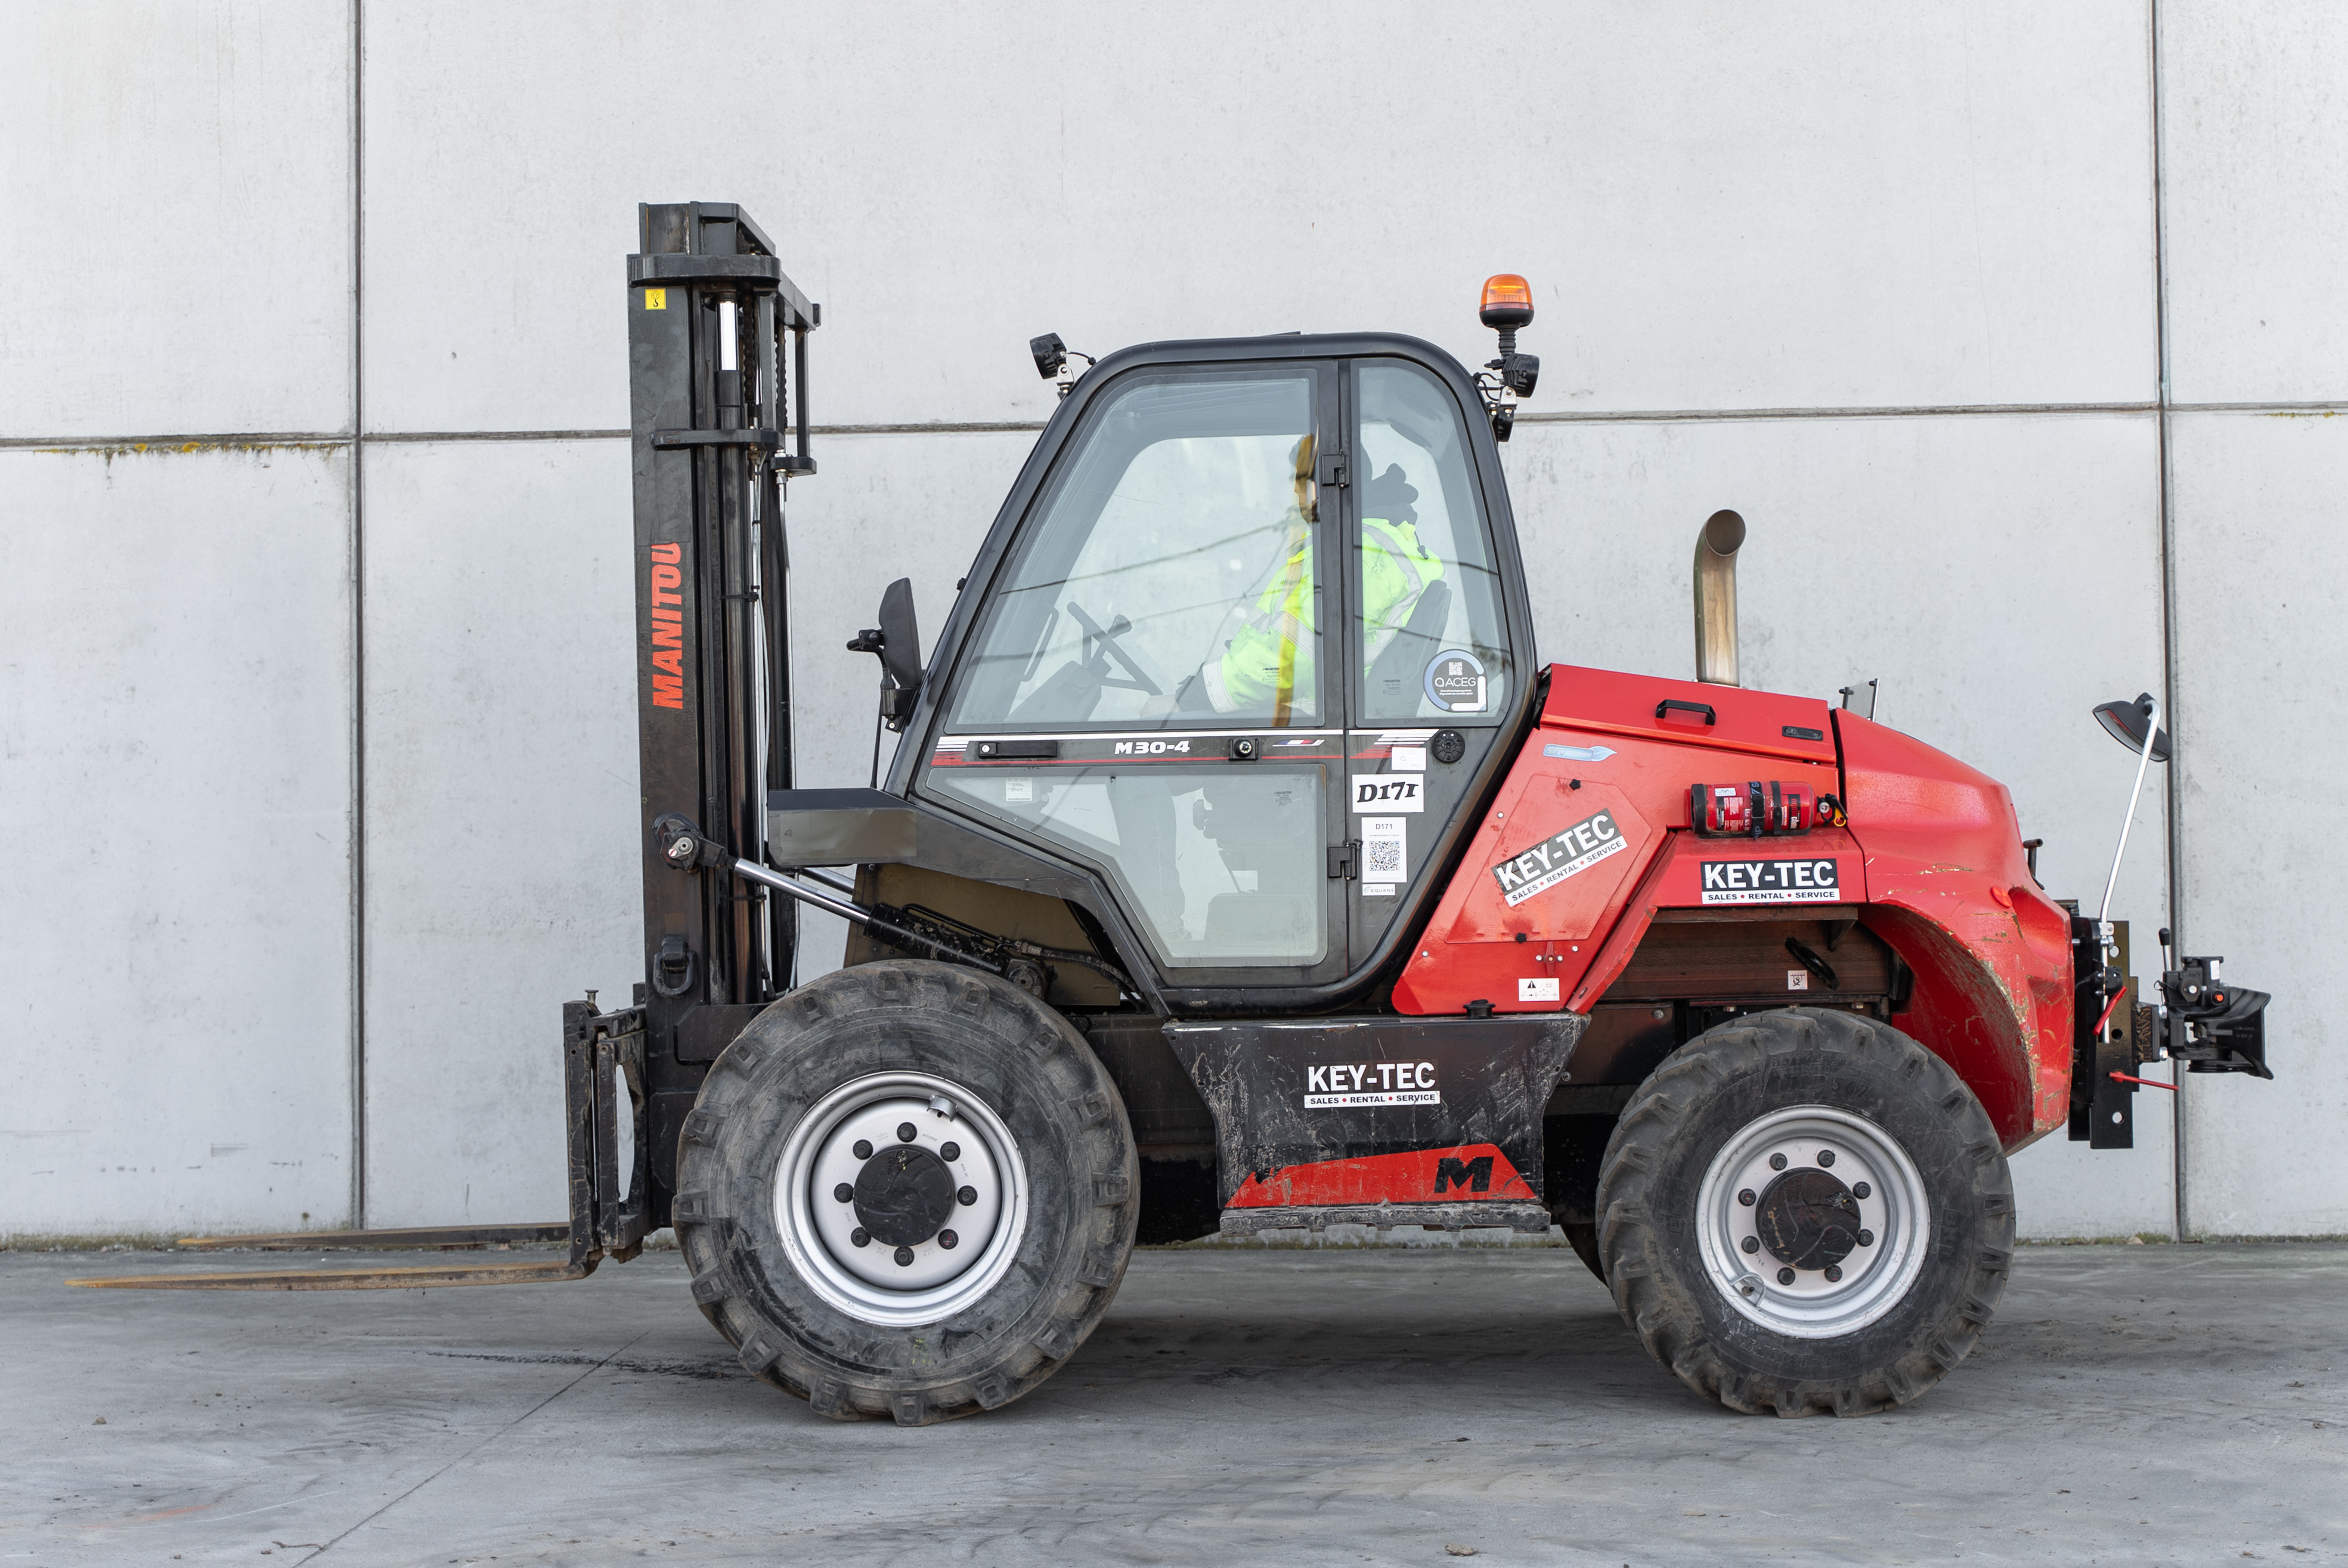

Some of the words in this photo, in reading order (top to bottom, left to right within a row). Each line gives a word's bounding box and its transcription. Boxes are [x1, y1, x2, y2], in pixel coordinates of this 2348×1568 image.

[651, 543, 683, 709] MANITOU
[1114, 740, 1191, 755] M30-4
[1357, 782, 1419, 802] D171
[1496, 814, 1615, 891] KEY-TEC
[1511, 884, 1538, 901] SALES
[1546, 863, 1579, 884] RENTAL
[1587, 841, 1622, 862] SERVICE
[1704, 861, 1835, 889] KEY-TEC
[1308, 1062, 1436, 1092] KEY-TEC
[1831, 1077, 1872, 1098] 567
[1434, 1156, 1494, 1193] M
